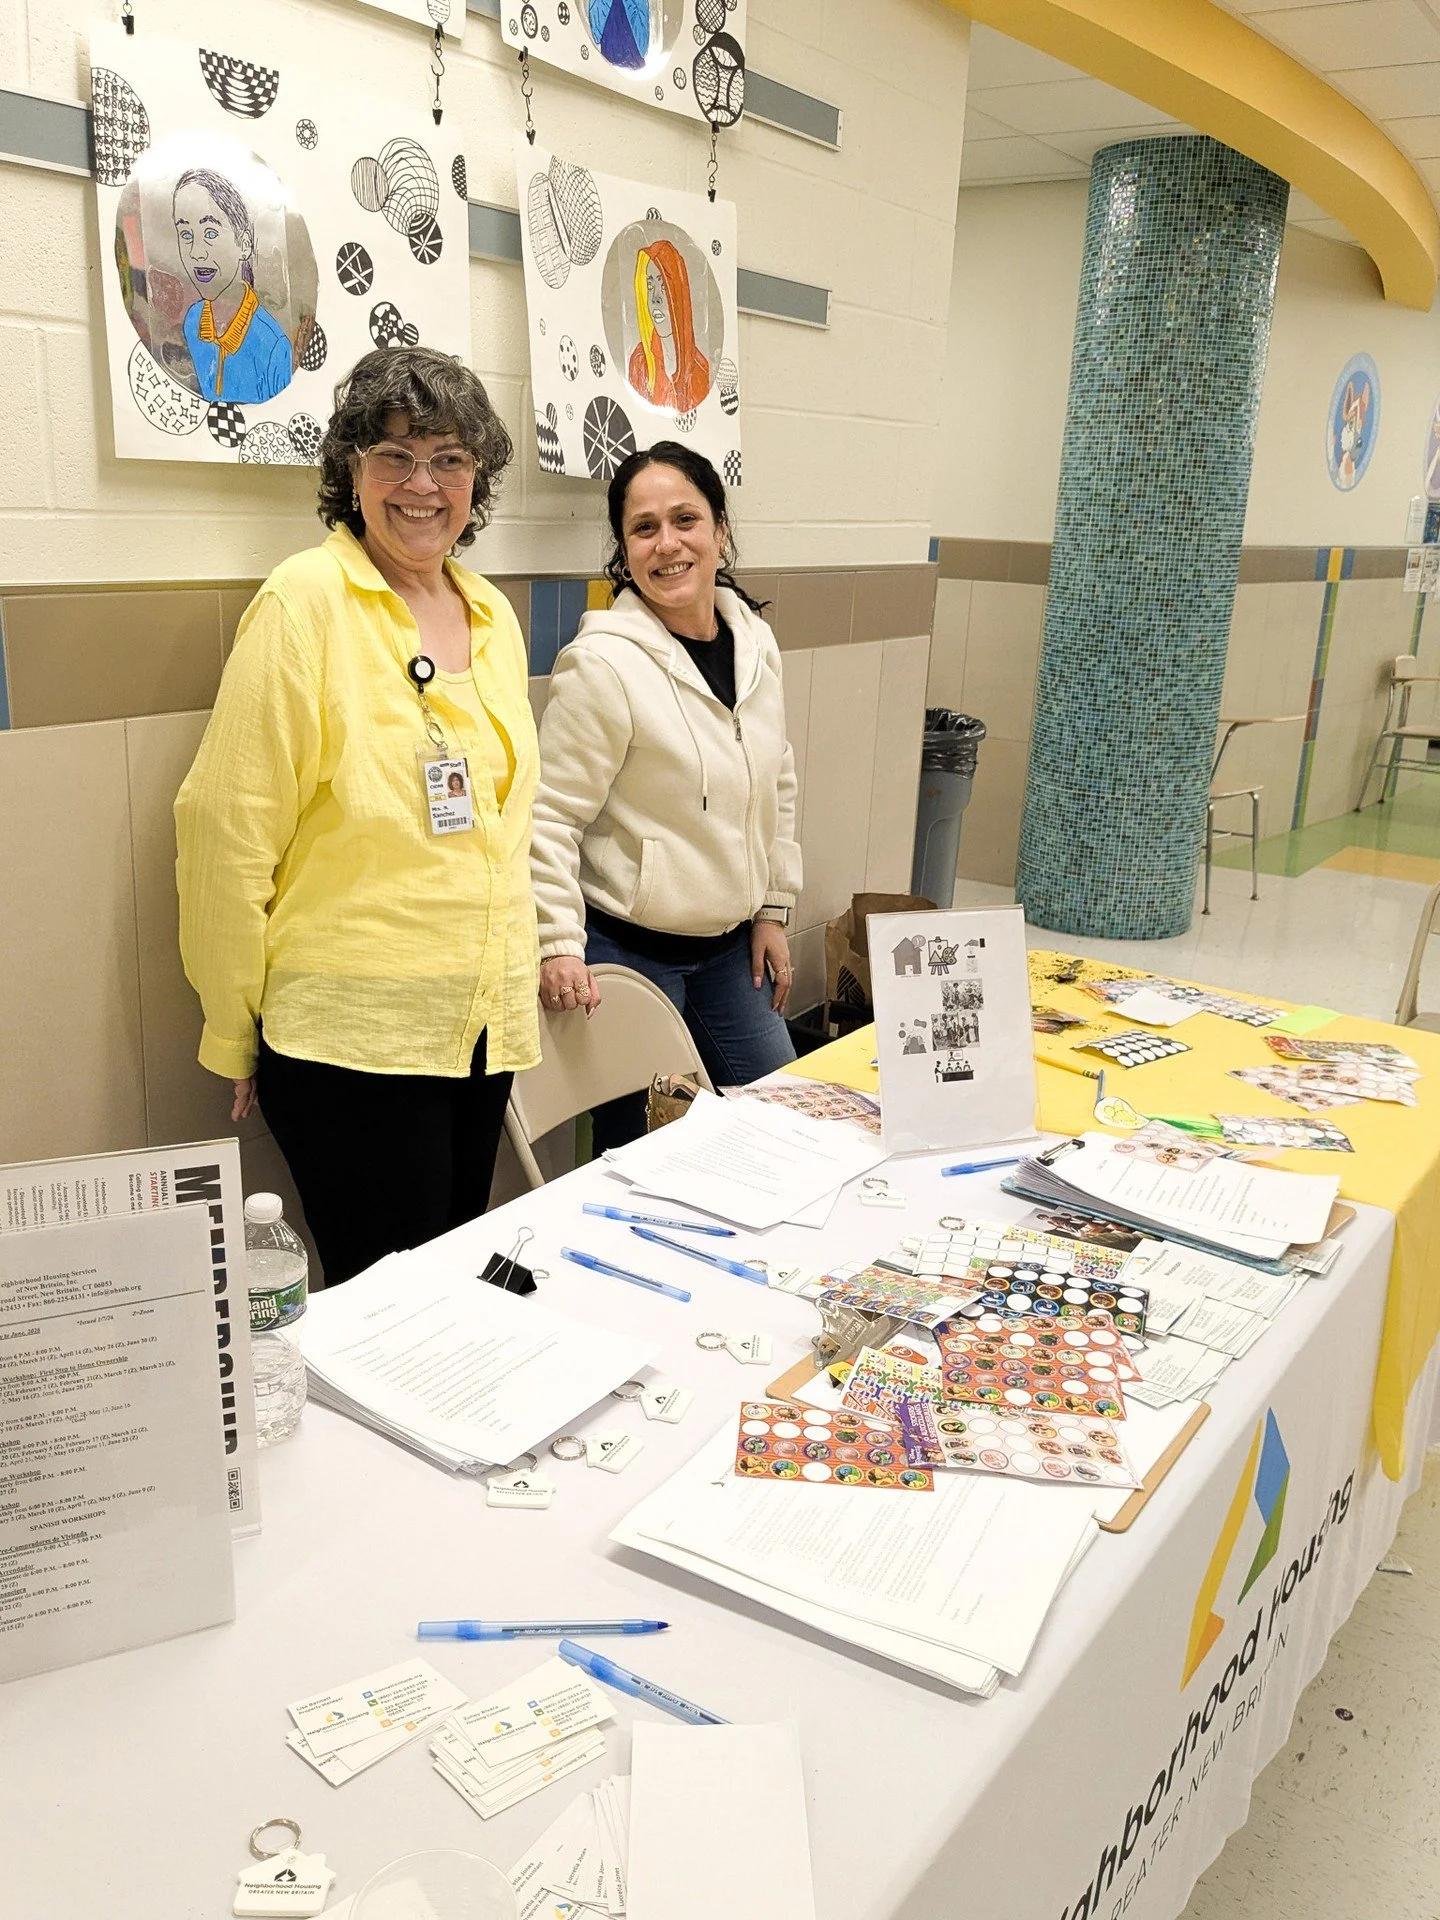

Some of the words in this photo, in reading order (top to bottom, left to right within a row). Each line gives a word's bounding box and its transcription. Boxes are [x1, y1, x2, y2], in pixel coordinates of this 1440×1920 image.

[432, 811, 455, 819] Sanchez
[160, 1170, 169, 1202] ANNUAL
[42, 1271, 70, 1282] Housing
[70, 1266, 98, 1277] Services
[24, 1284, 38, 1292] New
[40, 1280, 63, 1289] Britain,
[40, 1290, 54, 1298] New
[56, 1285, 81, 1295] Britain,
[81, 1283, 92, 1291] CT
[27, 1300, 41, 1308] Fax:
[77, 1361, 95, 1370] Home
[96, 1355, 128, 1367] Ownership
[59, 1377, 86, 1387] February
[104, 1370, 123, 1379] March
[139, 1364, 157, 1372] March
[111, 1430, 129, 1439] March
[29, 1520, 59, 1531] SPANISH
[61, 1510, 106, 1524] WORKSHOPS
[306, 1718, 346, 1736] Neighborhood
[346, 1710, 369, 1722] Housing
[477, 1728, 515, 1746] Neighborhood
[515, 1720, 536, 1731] Housing
[1187, 1720, 1229, 1804] NEW
[520, 1862, 534, 1877] Jones
[526, 1861, 544, 1881] Assistant
[566, 1863, 580, 1884] Lucretia
[577, 1847, 587, 1864] Jones
[616, 1883, 625, 1907] Lucretia
